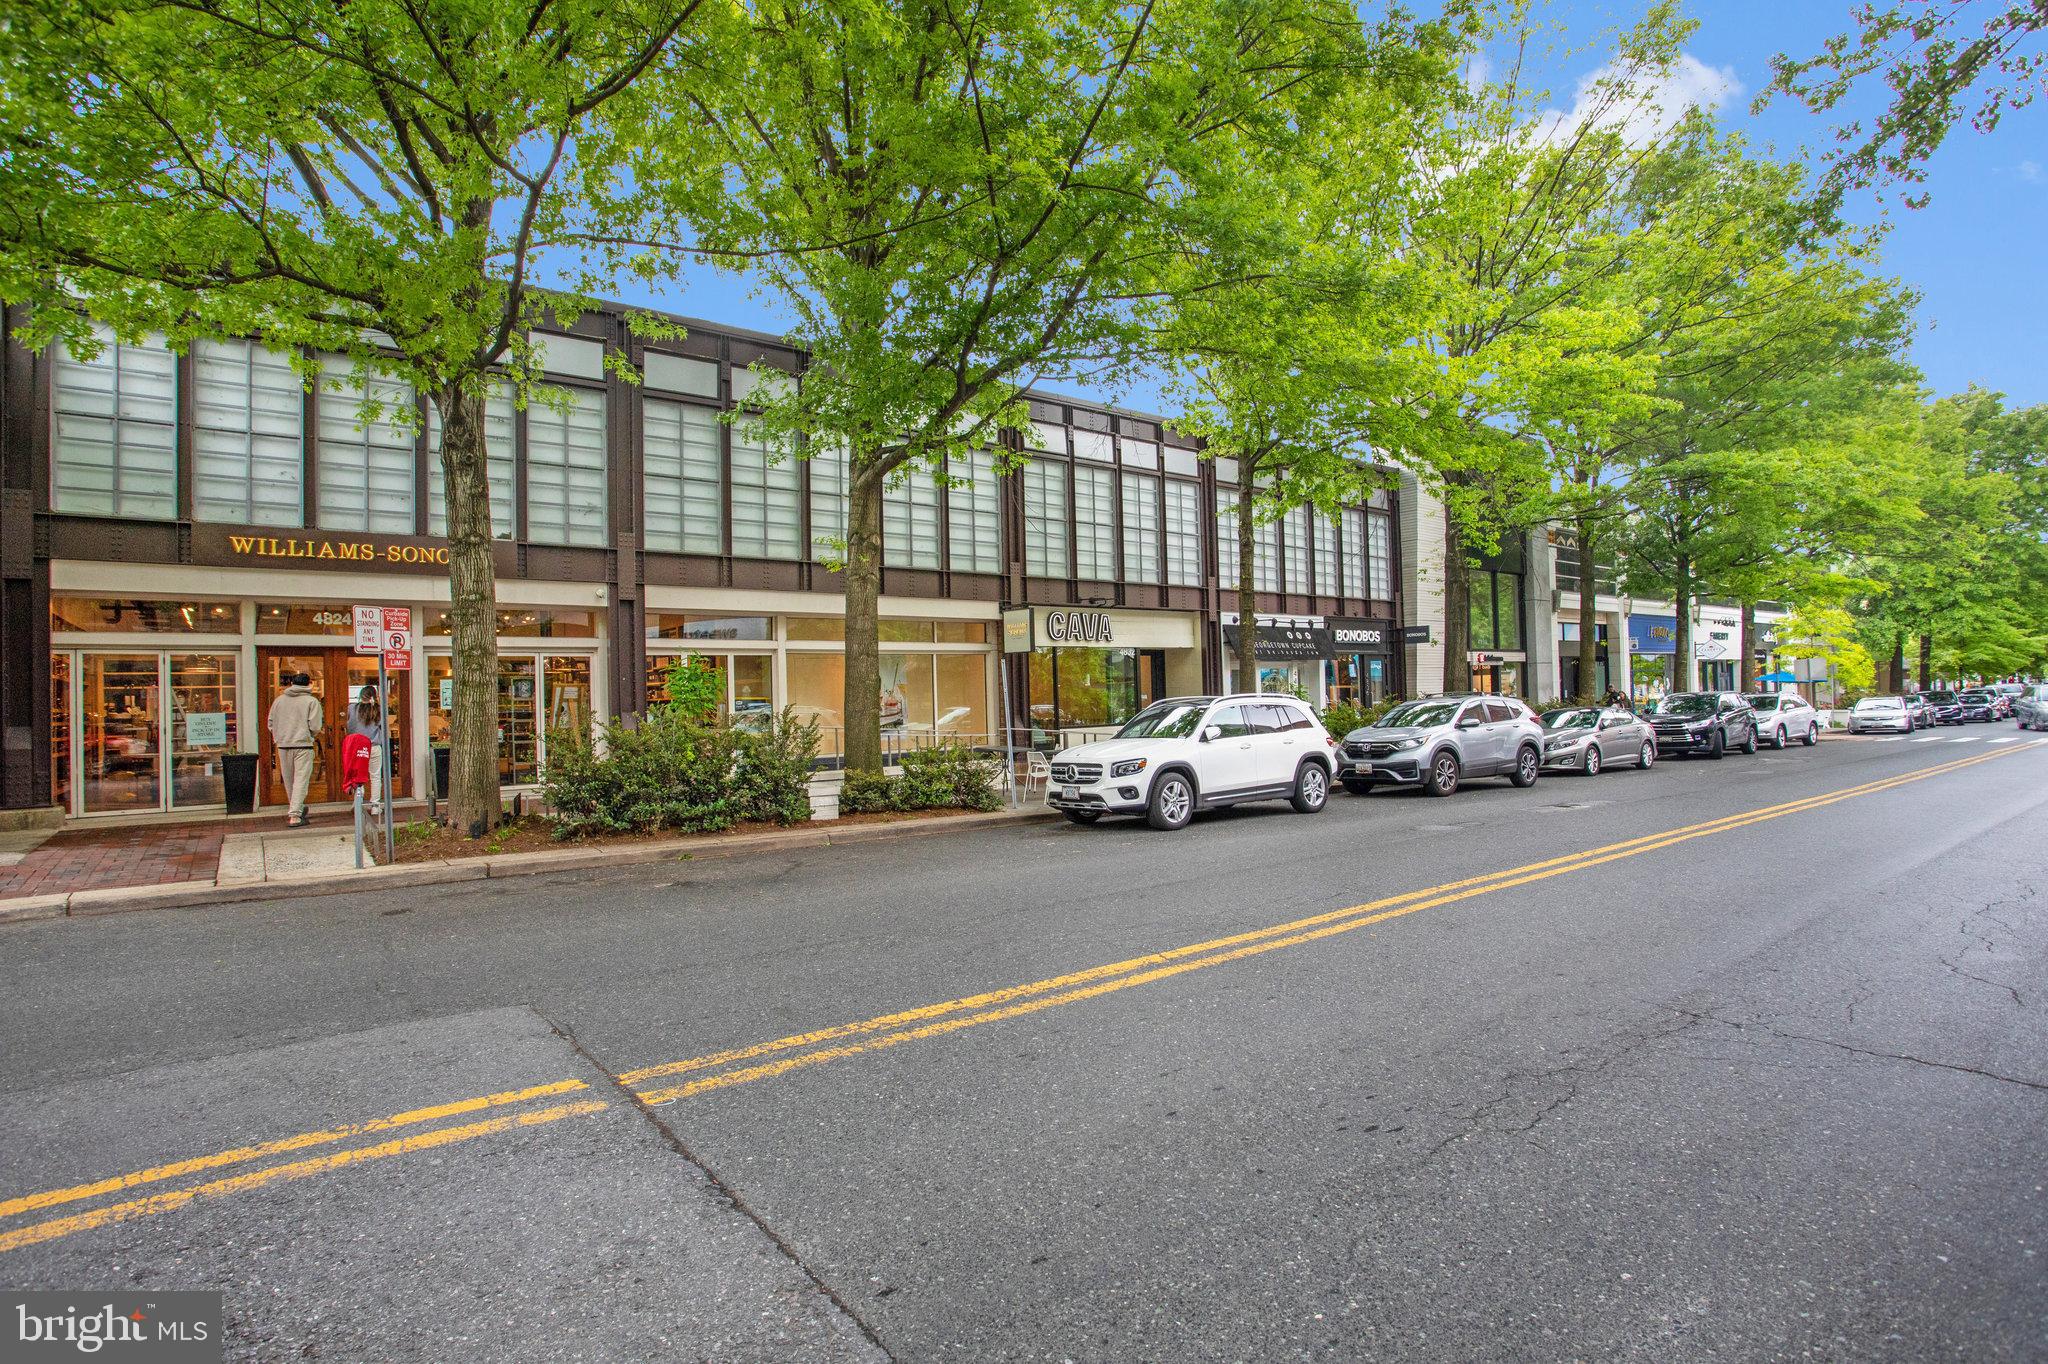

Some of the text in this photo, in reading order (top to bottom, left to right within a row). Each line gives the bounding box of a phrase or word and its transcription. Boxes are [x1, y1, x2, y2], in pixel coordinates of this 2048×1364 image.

[313, 612, 352, 625] 4824
[361, 610, 375, 619] NO
[1048, 611, 1113, 641] CAVA
[1336, 630, 1380, 642] BONOBOS
[1291, 642, 1316, 650] CUPCAKE
[1119, 648, 1136, 657] 4832
